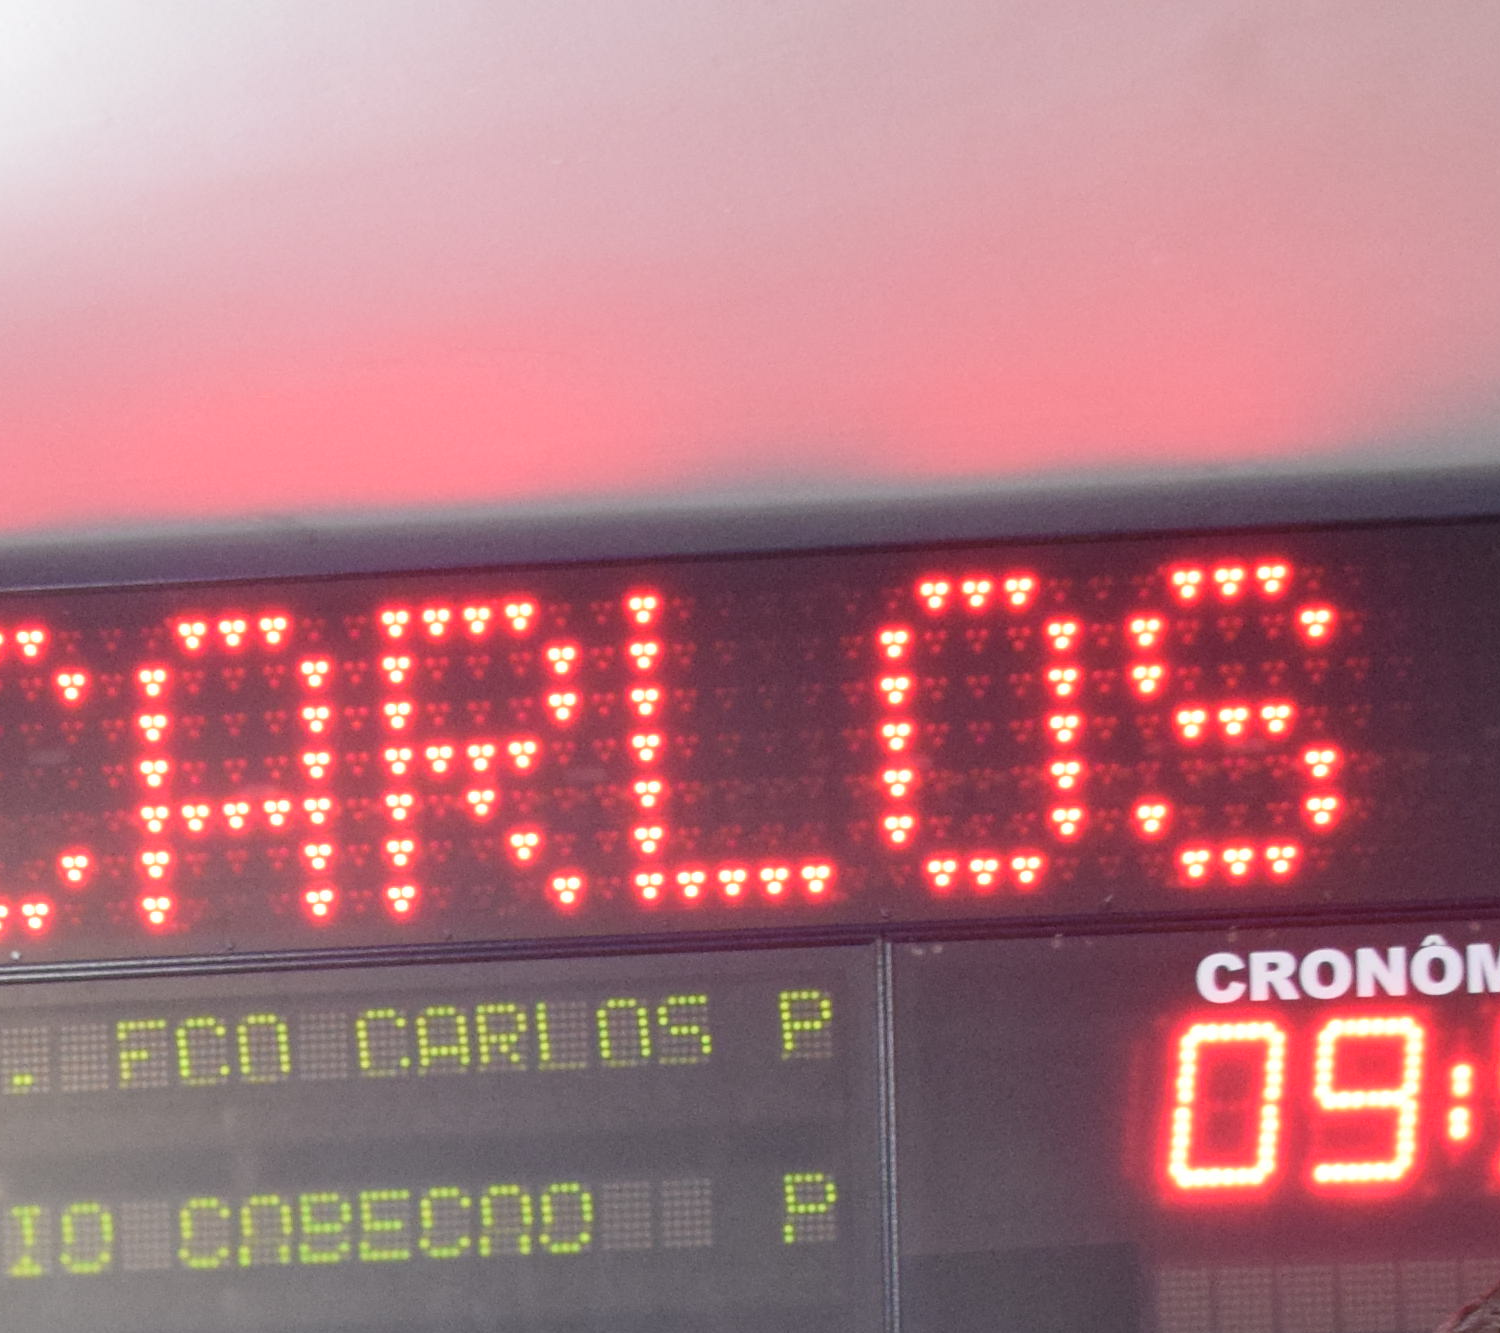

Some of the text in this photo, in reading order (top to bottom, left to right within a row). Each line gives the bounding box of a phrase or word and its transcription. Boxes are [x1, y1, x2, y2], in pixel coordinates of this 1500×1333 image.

[115, 1012, 292, 1086] FCO
[353, 993, 714, 1075] CARLOS
[778, 989, 834, 1055] P
[783, 1171, 839, 1245] P
